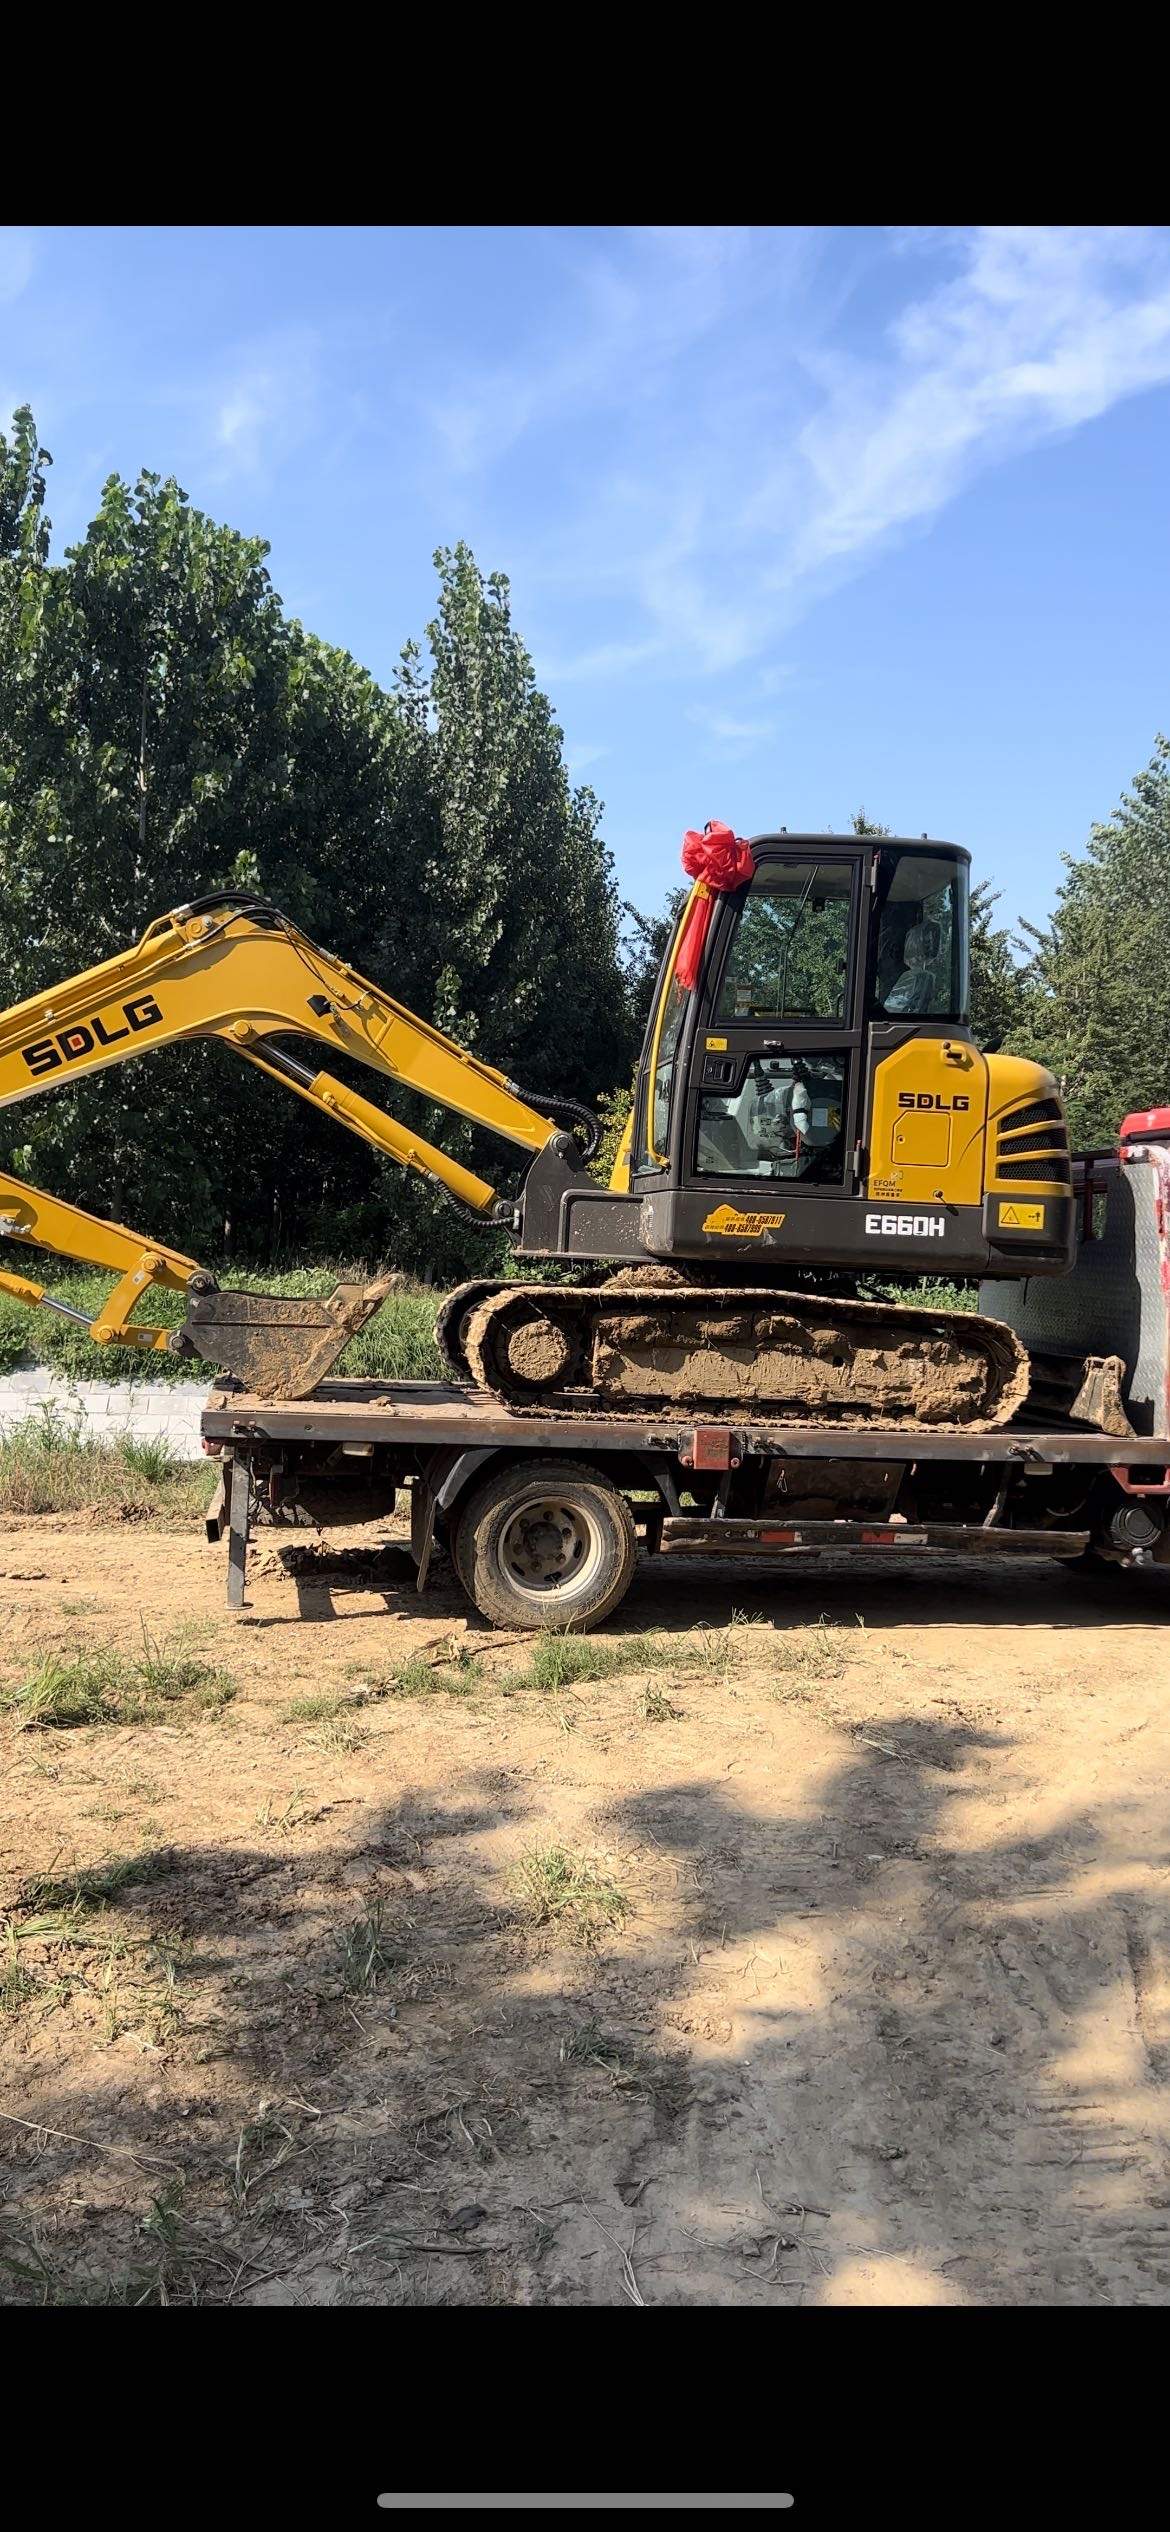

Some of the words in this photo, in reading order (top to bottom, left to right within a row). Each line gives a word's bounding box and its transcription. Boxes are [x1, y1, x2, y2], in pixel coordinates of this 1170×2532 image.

[22, 994, 164, 1077] SDLG
[898, 1092, 970, 1112] SDLG
[873, 1179, 896, 1188] EFQM
[865, 1213, 945, 1237] E660H
